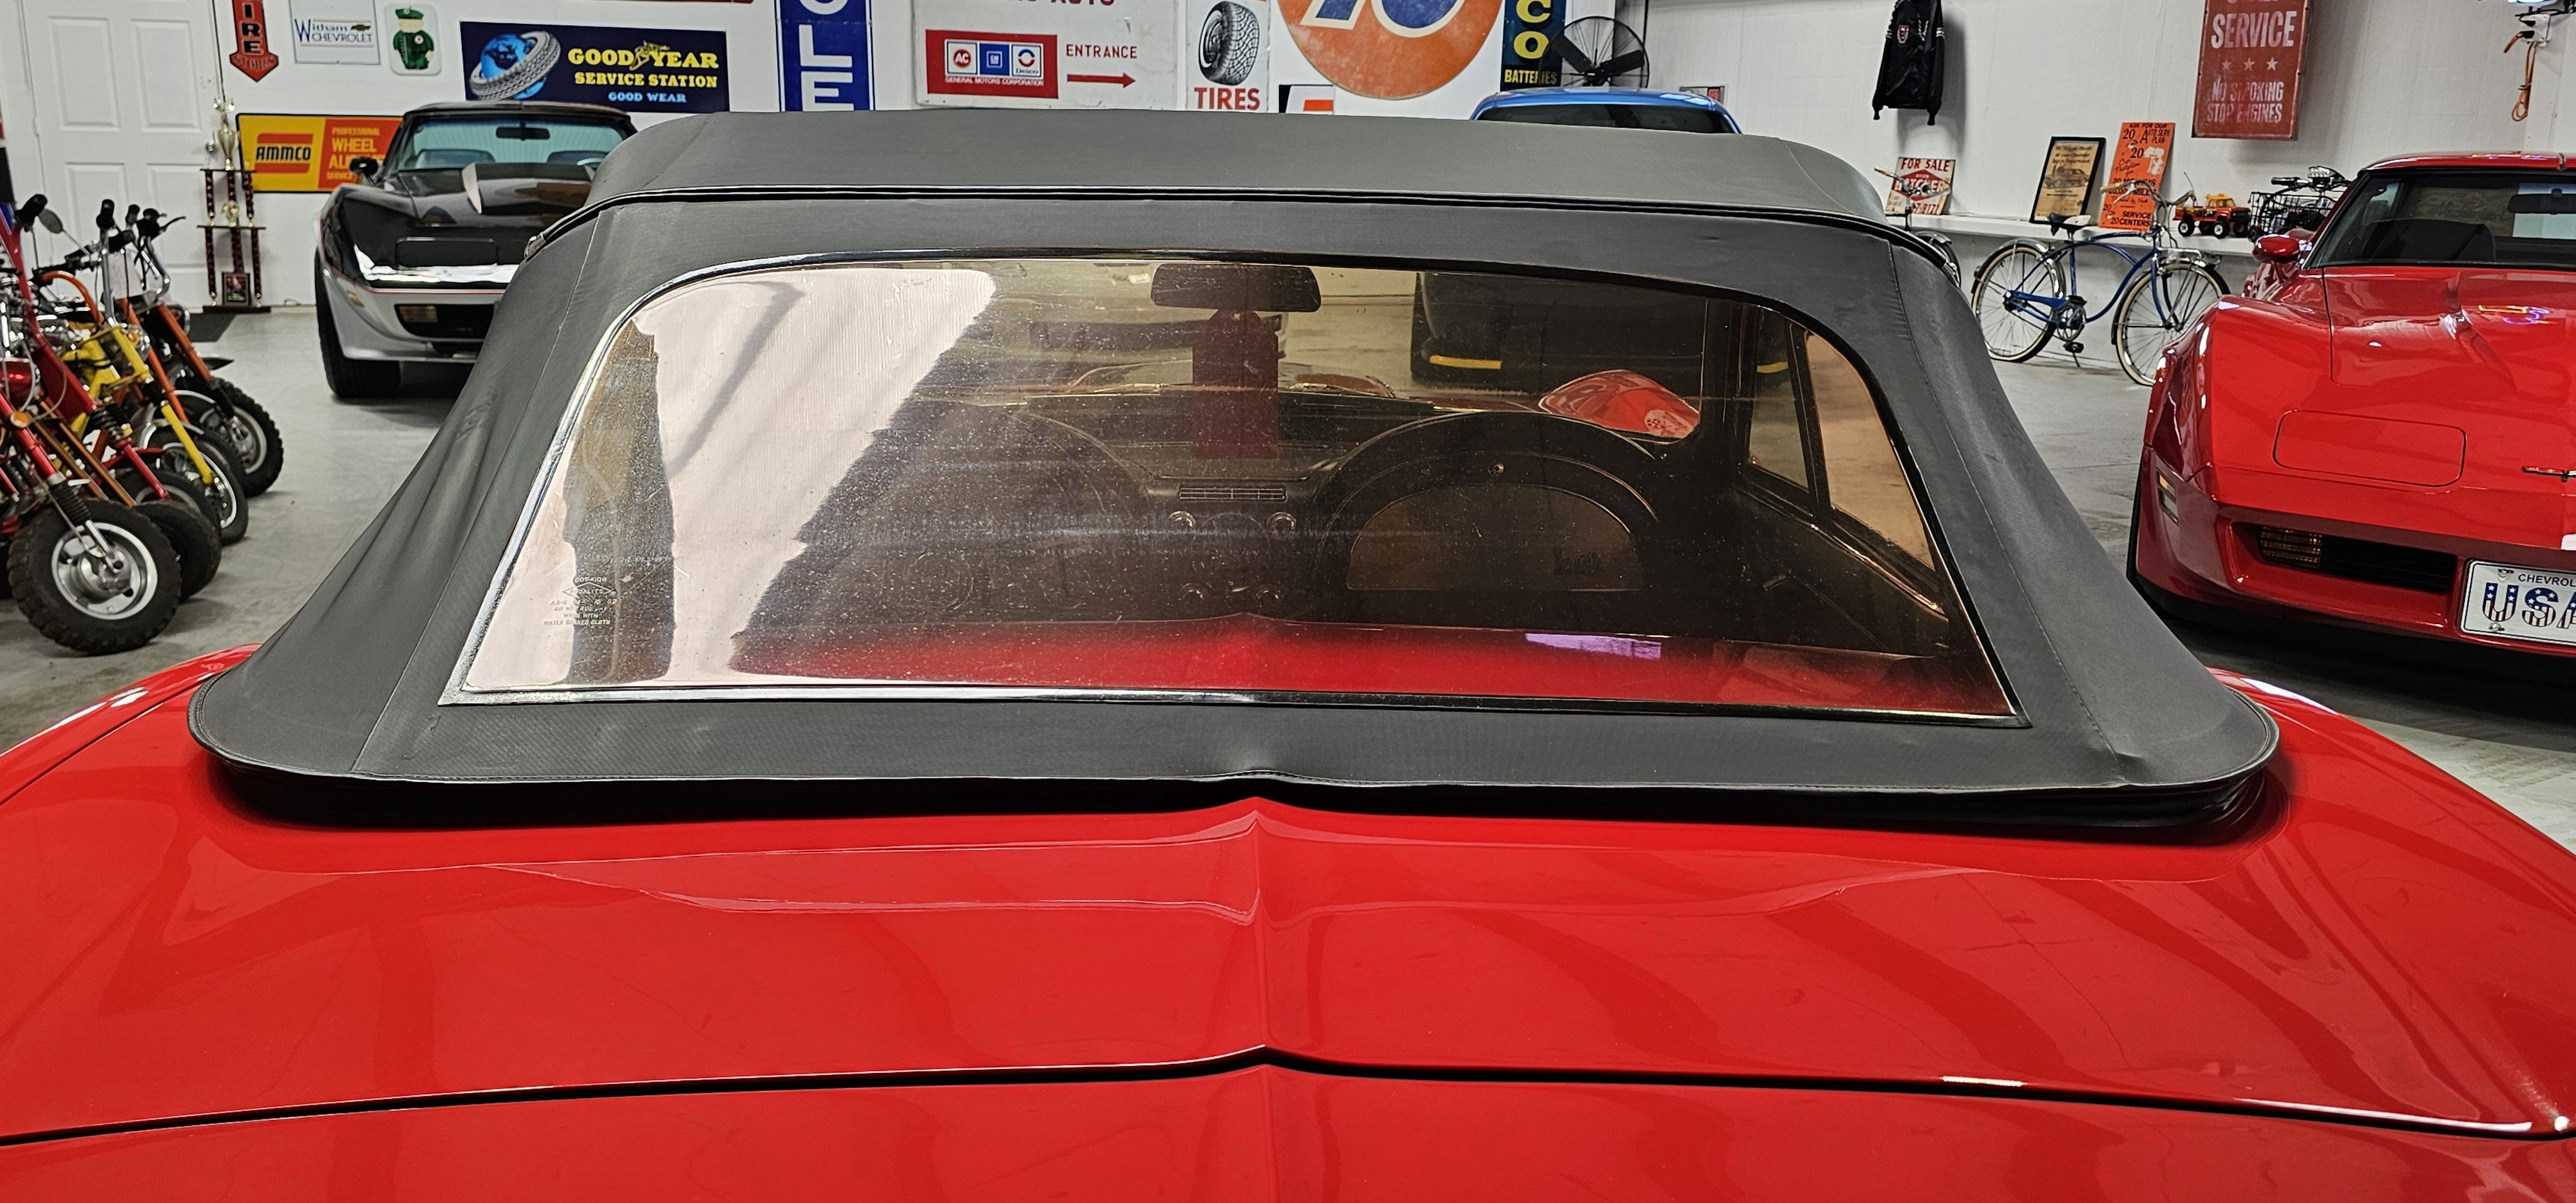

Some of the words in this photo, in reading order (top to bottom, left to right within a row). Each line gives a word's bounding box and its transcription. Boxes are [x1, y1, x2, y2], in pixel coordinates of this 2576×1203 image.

[239, 0, 264, 55] IRE
[294, 19, 348, 42] Witham
[2211, 11, 2297, 48] SERVICE
[312, 33, 373, 43] CHEVROLET
[954, 52, 970, 63] AC
[1066, 44, 1137, 59] ENTRANCE
[574, 71, 644, 86] SERVICE
[649, 73, 717, 88] STATION
[608, 91, 643, 102] GOOD
[647, 92, 687, 102] WEAR
[2211, 77, 2227, 101] NO
[1194, 87, 1260, 111] TIRES
[2207, 103, 2234, 122] STOP
[2123, 128, 2136, 139] 20
[332, 137, 377, 153] WHEEL
[2130, 147, 2144, 158] 20
[256, 146, 311, 161] AMMCO
[1901, 158, 1921, 169] FOR
[1925, 159, 1951, 172] SALE
[2518, 573, 2576, 587] CHEVROL
